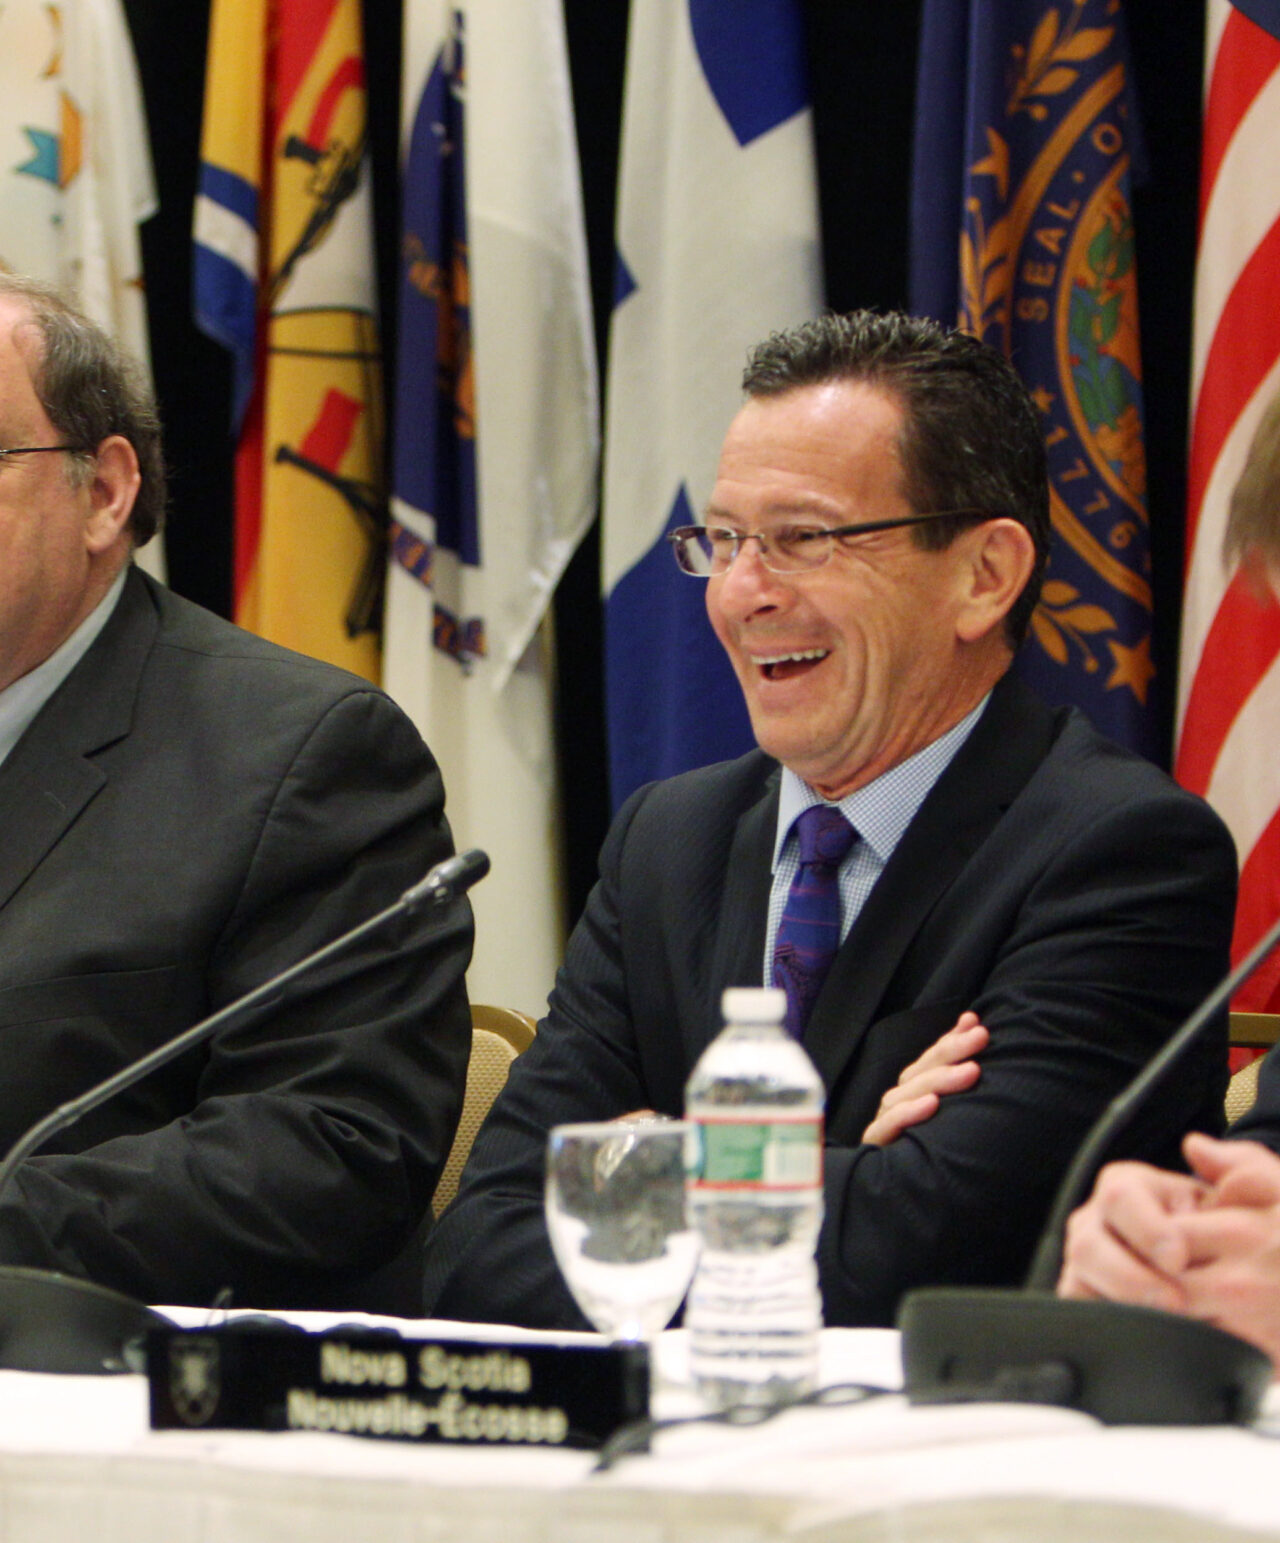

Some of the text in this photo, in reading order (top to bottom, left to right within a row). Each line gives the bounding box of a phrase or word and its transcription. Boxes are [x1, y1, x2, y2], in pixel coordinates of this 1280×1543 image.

[1017, 198, 1080, 323] SEAL
[1045, 425, 1139, 550] 1776
[321, 1342, 532, 1393] Nova Scotia
[287, 1388, 569, 1444] Nouvelle-Écosse
